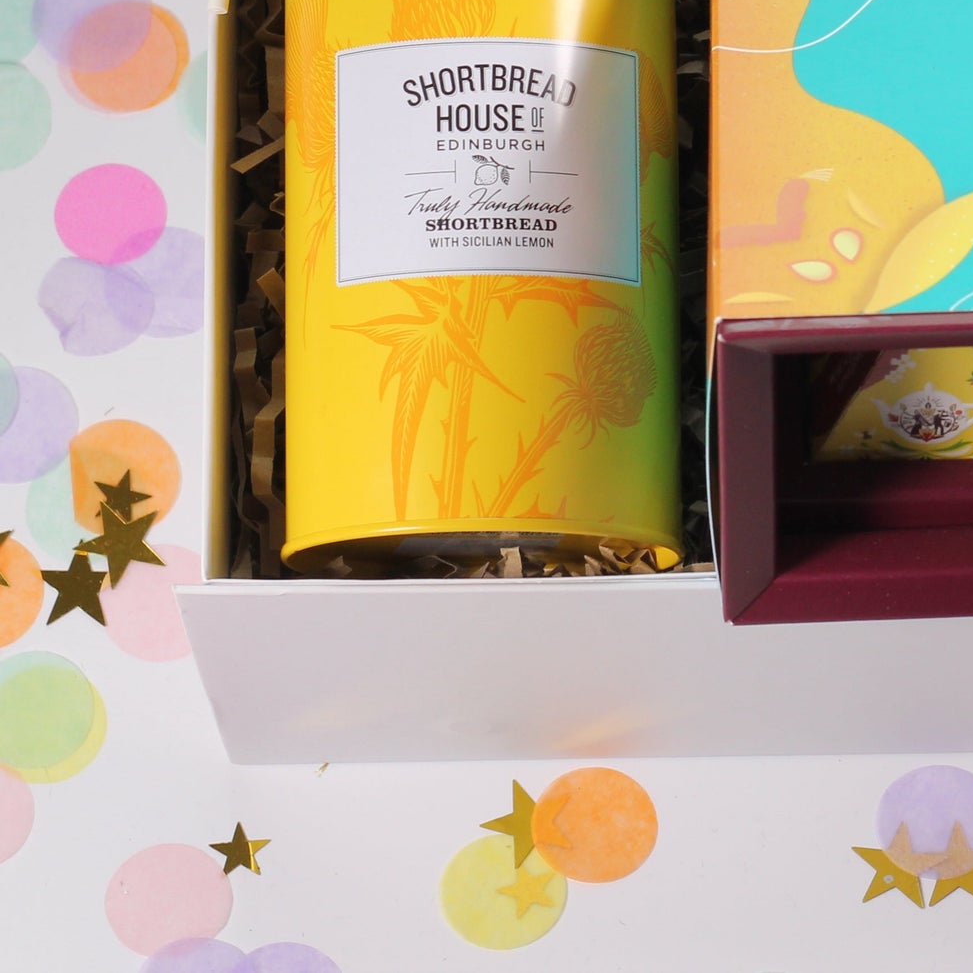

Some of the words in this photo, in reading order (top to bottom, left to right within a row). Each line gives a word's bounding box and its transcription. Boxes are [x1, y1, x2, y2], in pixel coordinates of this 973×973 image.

[403, 64, 576, 107] SHORTBREAD
[436, 104, 525, 133] HOUSE
[531, 107, 544, 128] OF
[437, 139, 545, 151] EDINBURGH
[404, 188, 460, 222] Truly
[464, 187, 574, 216] Handmade
[426, 217, 558, 232] SHORTBREAD
[429, 237, 459, 248] WITH
[463, 236, 511, 248] SICILIAN
[516, 237, 554, 248] LEMON
